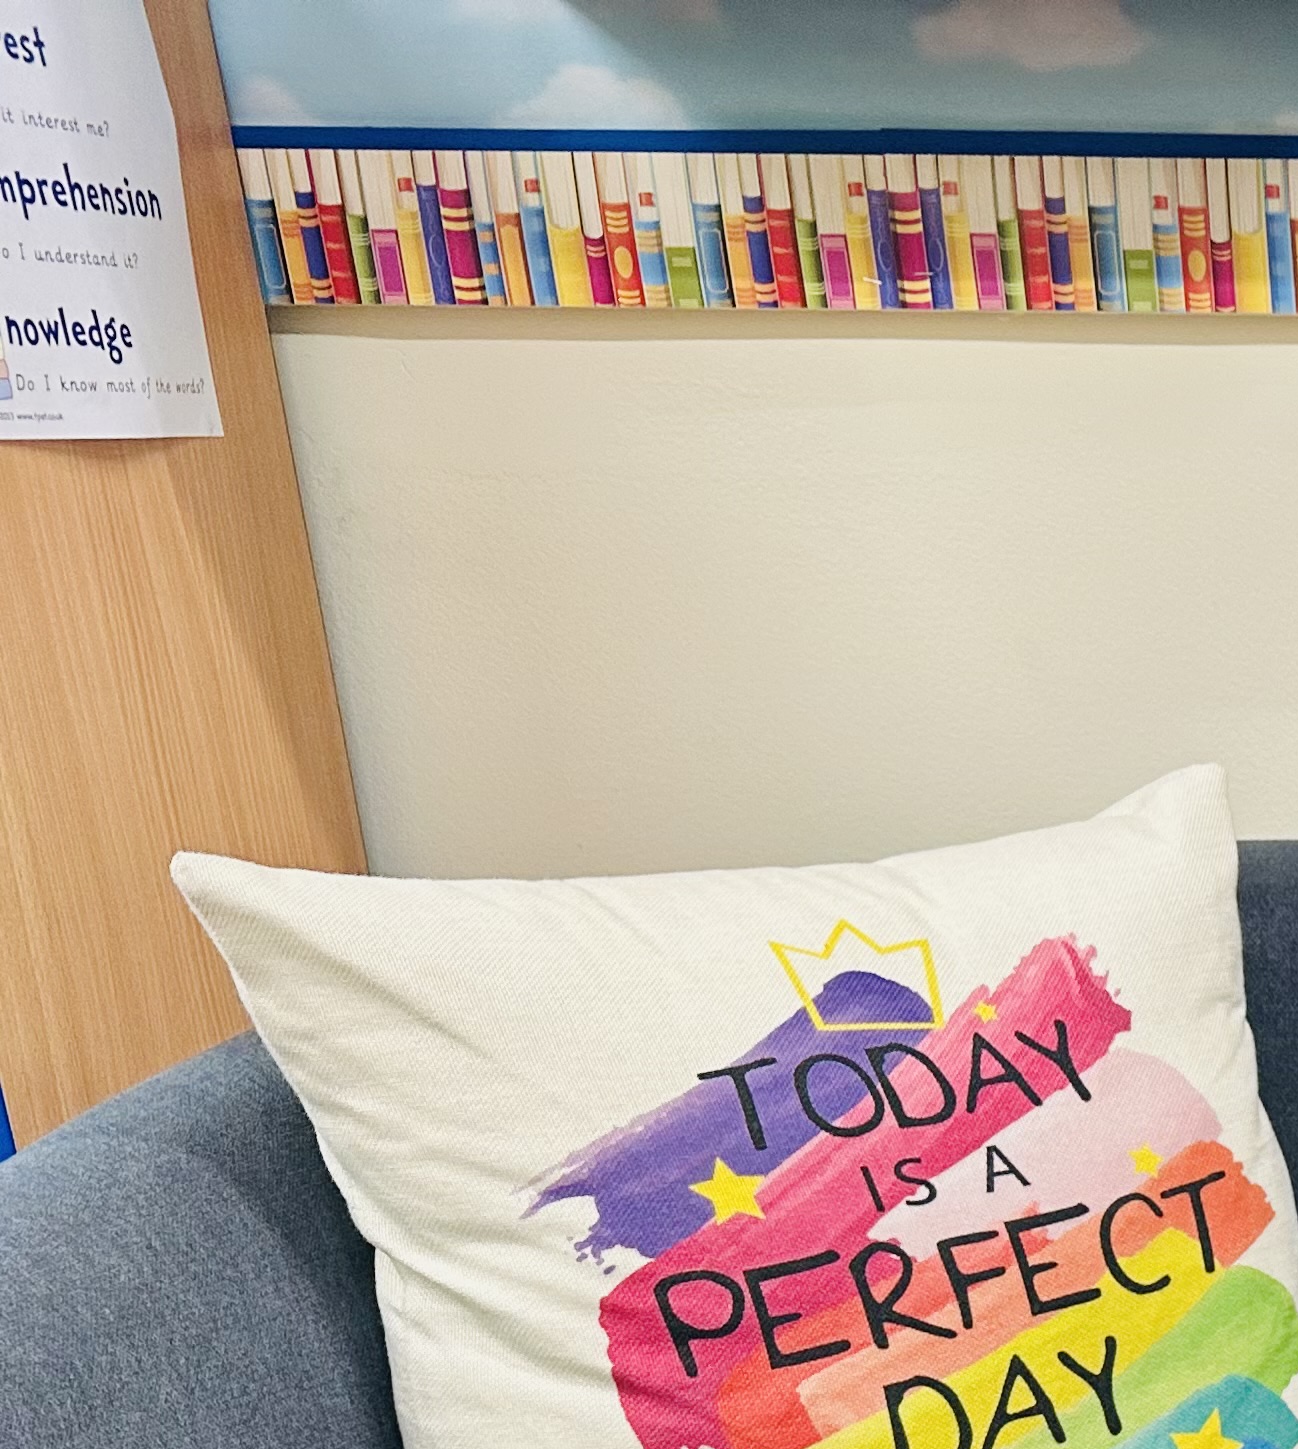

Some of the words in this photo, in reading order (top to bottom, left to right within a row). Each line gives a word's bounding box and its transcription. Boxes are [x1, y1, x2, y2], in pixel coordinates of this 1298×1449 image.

[2, 26, 47, 67] est
[22, 110, 80, 133] interest
[86, 120, 109, 138] me?
[18, 242, 25, 261] I
[34, 246, 118, 268] understand
[123, 252, 139, 269] it?
[5, 306, 133, 364] nowledge
[16, 374, 35, 391] Do
[44, 374, 51, 391] I
[59, 376, 98, 392] know
[106, 379, 136, 393] most
[141, 376, 151, 399] of
[155, 377, 172, 394] the
[176, 377, 205, 395] words?
[697, 1018, 1093, 1152] TODAY
[861, 1155, 938, 1214] IS
[983, 1144, 1032, 1194] A
[652, 1170, 1227, 1378] PERFECT
